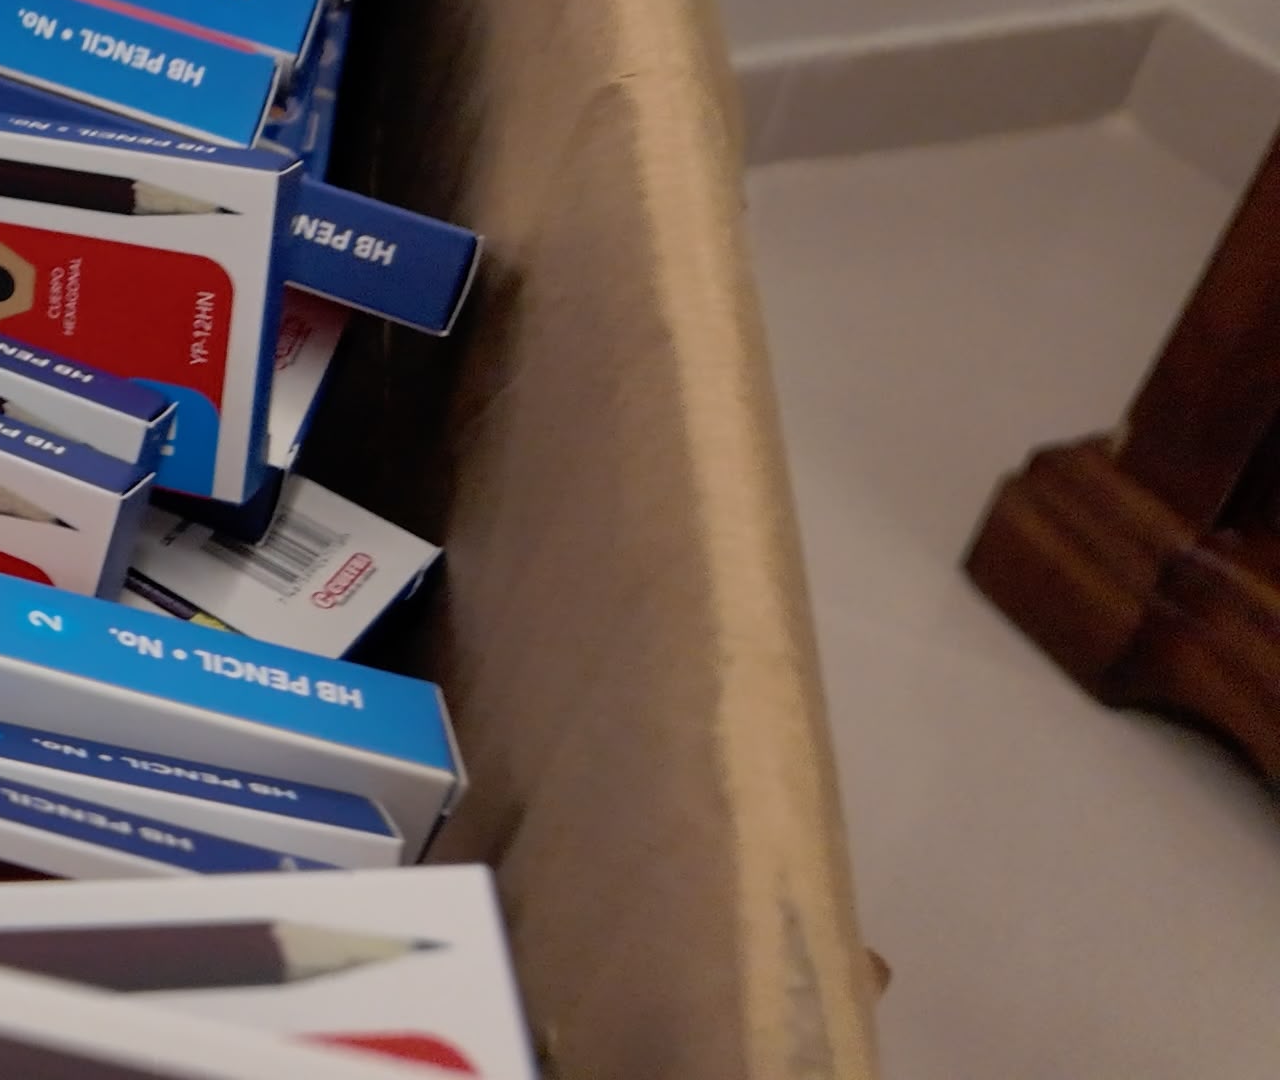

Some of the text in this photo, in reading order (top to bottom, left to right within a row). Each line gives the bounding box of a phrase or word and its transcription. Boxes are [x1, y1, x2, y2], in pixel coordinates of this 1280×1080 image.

[13, 6, 206, 86] HB PENCIL No.
[77, 127, 172, 147] PENCIL
[353, 236, 397, 266] HB
[48, 266, 65, 321] CUERPO
[62, 257, 83, 336] HEXAGONAL
[190, 290, 215, 366] YP-12HN
[52, 362, 93, 384] HB
[23, 432, 67, 456] HB
[28, 607, 61, 631] 2
[107, 625, 163, 660] No.
[193, 646, 310, 696] PENCIL
[314, 677, 364, 710] HB
[31, 738, 87, 758] No.
[119, 754, 241, 790] PENCIL
[247, 781, 297, 801] HB
[141, 825, 190, 851] HB
